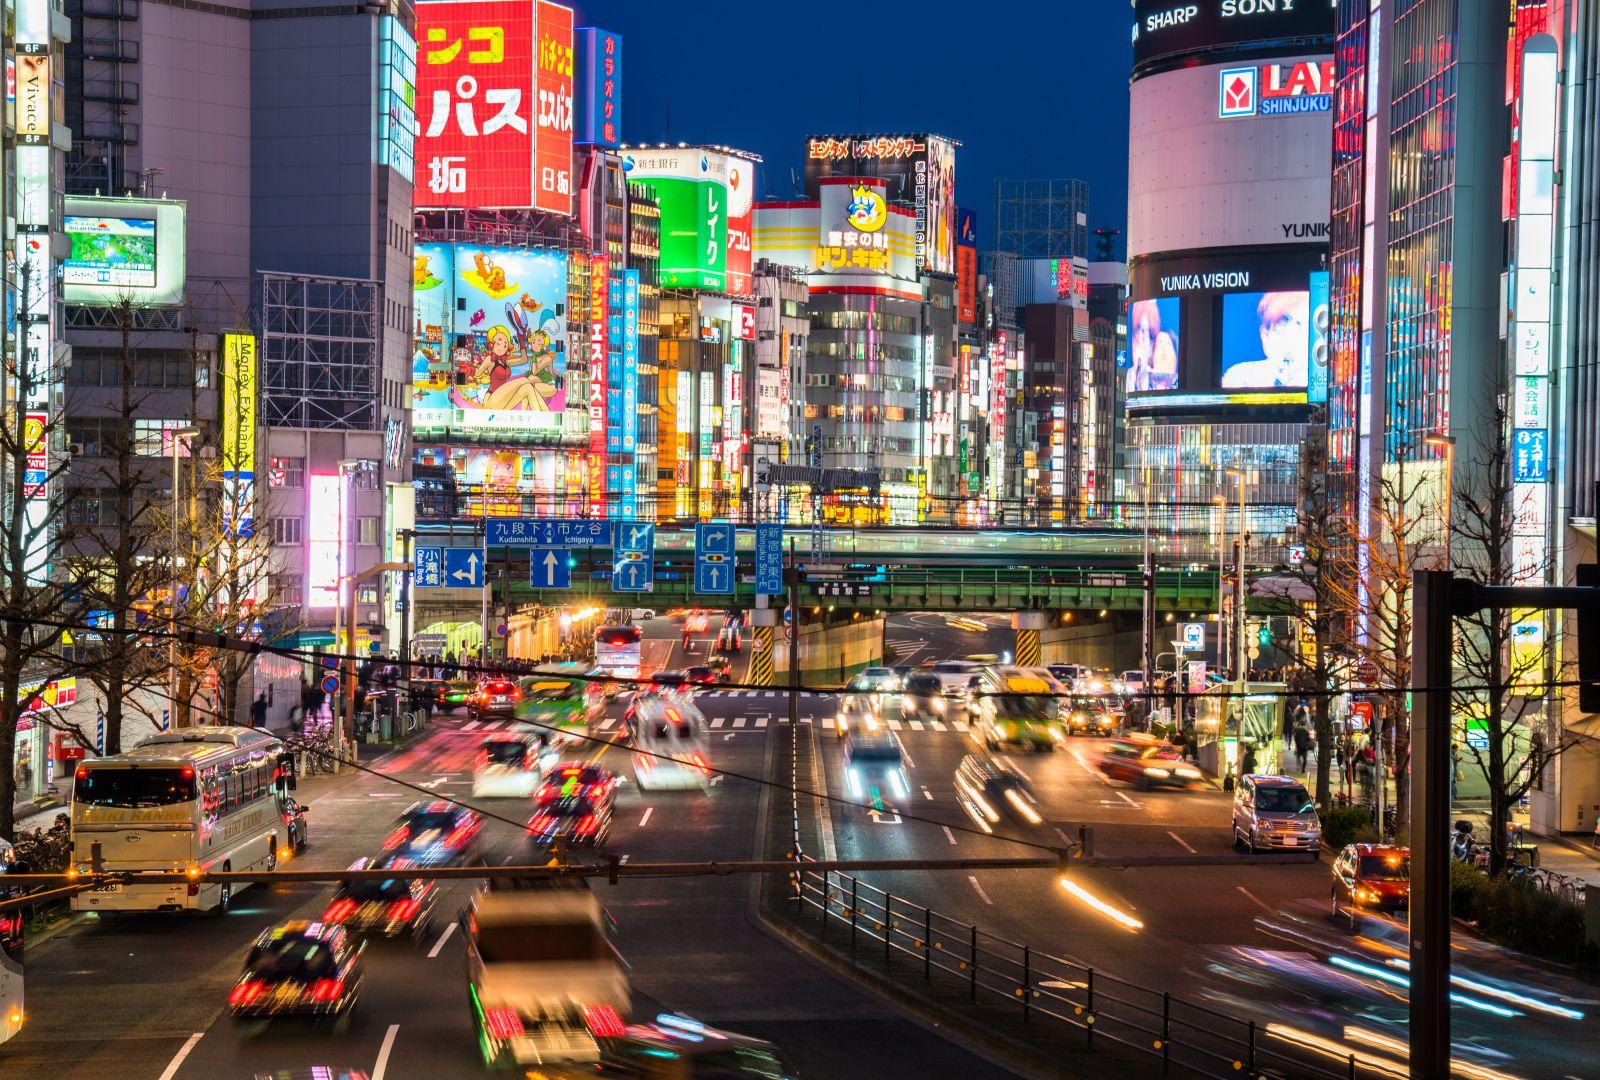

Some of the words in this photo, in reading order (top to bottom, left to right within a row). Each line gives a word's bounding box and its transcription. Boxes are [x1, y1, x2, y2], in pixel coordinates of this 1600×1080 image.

[1146, 6, 1198, 32] SHARP
[1222, 0, 1294, 17] SONY
[25, 44, 39, 53] 6F
[416, 26, 504, 64] ンコ
[539, 33, 572, 77] パチンコ
[604, 37, 615, 142] カラオケ館
[26, 76, 39, 131] Vivace
[413, 75, 528, 138] パス
[538, 84, 573, 132] エスパス
[1262, 97, 1329, 114] SHINJUKU
[25, 134, 40, 143] 5F
[810, 141, 848, 161] エンタメ
[638, 158, 679, 169] 新生銀行
[542, 167, 569, 195] 日拓
[706, 187, 719, 266] レイク
[727, 229, 751, 251] アコム
[1282, 223, 1331, 238] YUNIK
[591, 262, 604, 319] パチンコ
[1161, 276, 1200, 291] YUNIKA
[1203, 272, 1249, 287] VISION
[239, 344, 251, 390] Money
[590, 323, 603, 401] エスパス
[31, 459, 45, 468] ATM
[495, 522, 541, 535] 九段下
[557, 522, 602, 535] 市ヶ谷
[416, 549, 425, 567] Otaki
[758, 528, 767, 561] Shinjuku
[425, 550, 439, 585] 小滝橋
[767, 527, 779, 591] 新宿駅東口
[818, 587, 853, 596] 新宿駅
[130, 809, 189, 821] KANKO
[224, 818, 242, 841] SAIKI
[242, 809, 263, 831] KANKO
